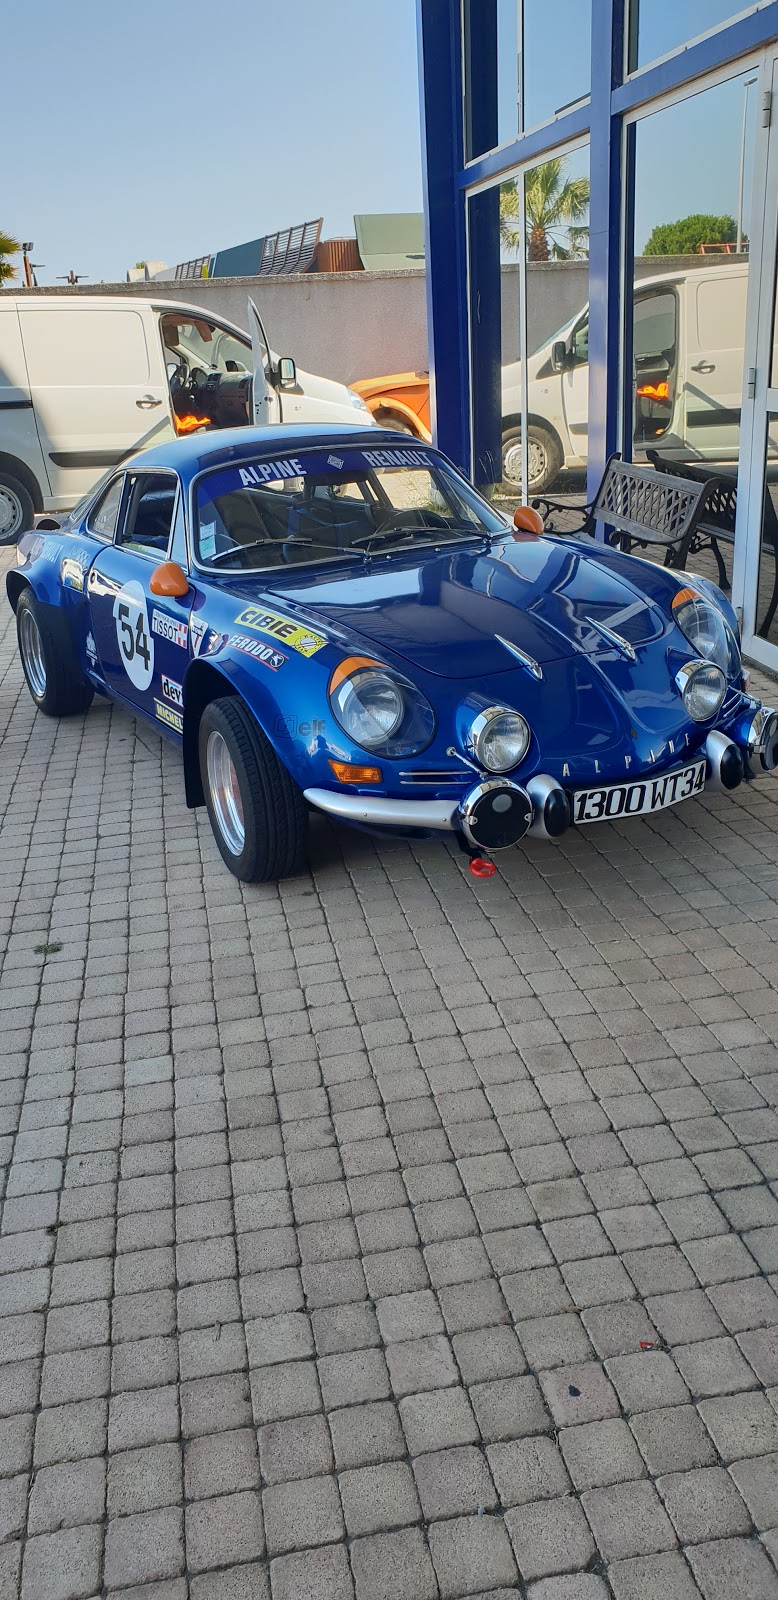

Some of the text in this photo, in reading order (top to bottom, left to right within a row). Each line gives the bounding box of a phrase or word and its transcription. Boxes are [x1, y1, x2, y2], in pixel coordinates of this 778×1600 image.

[238, 458, 308, 487] ALPINE
[361, 450, 434, 467] RENAULT
[118, 603, 151, 672] 54
[153, 617, 178, 644] TISSOT
[240, 610, 298, 638] CIBIE
[228, 634, 274, 661] FERODO
[163, 679, 183, 703] dev
[298, 719, 326, 737] elf
[562, 732, 691, 777] ALPINE
[575, 784, 647, 822] 1300
